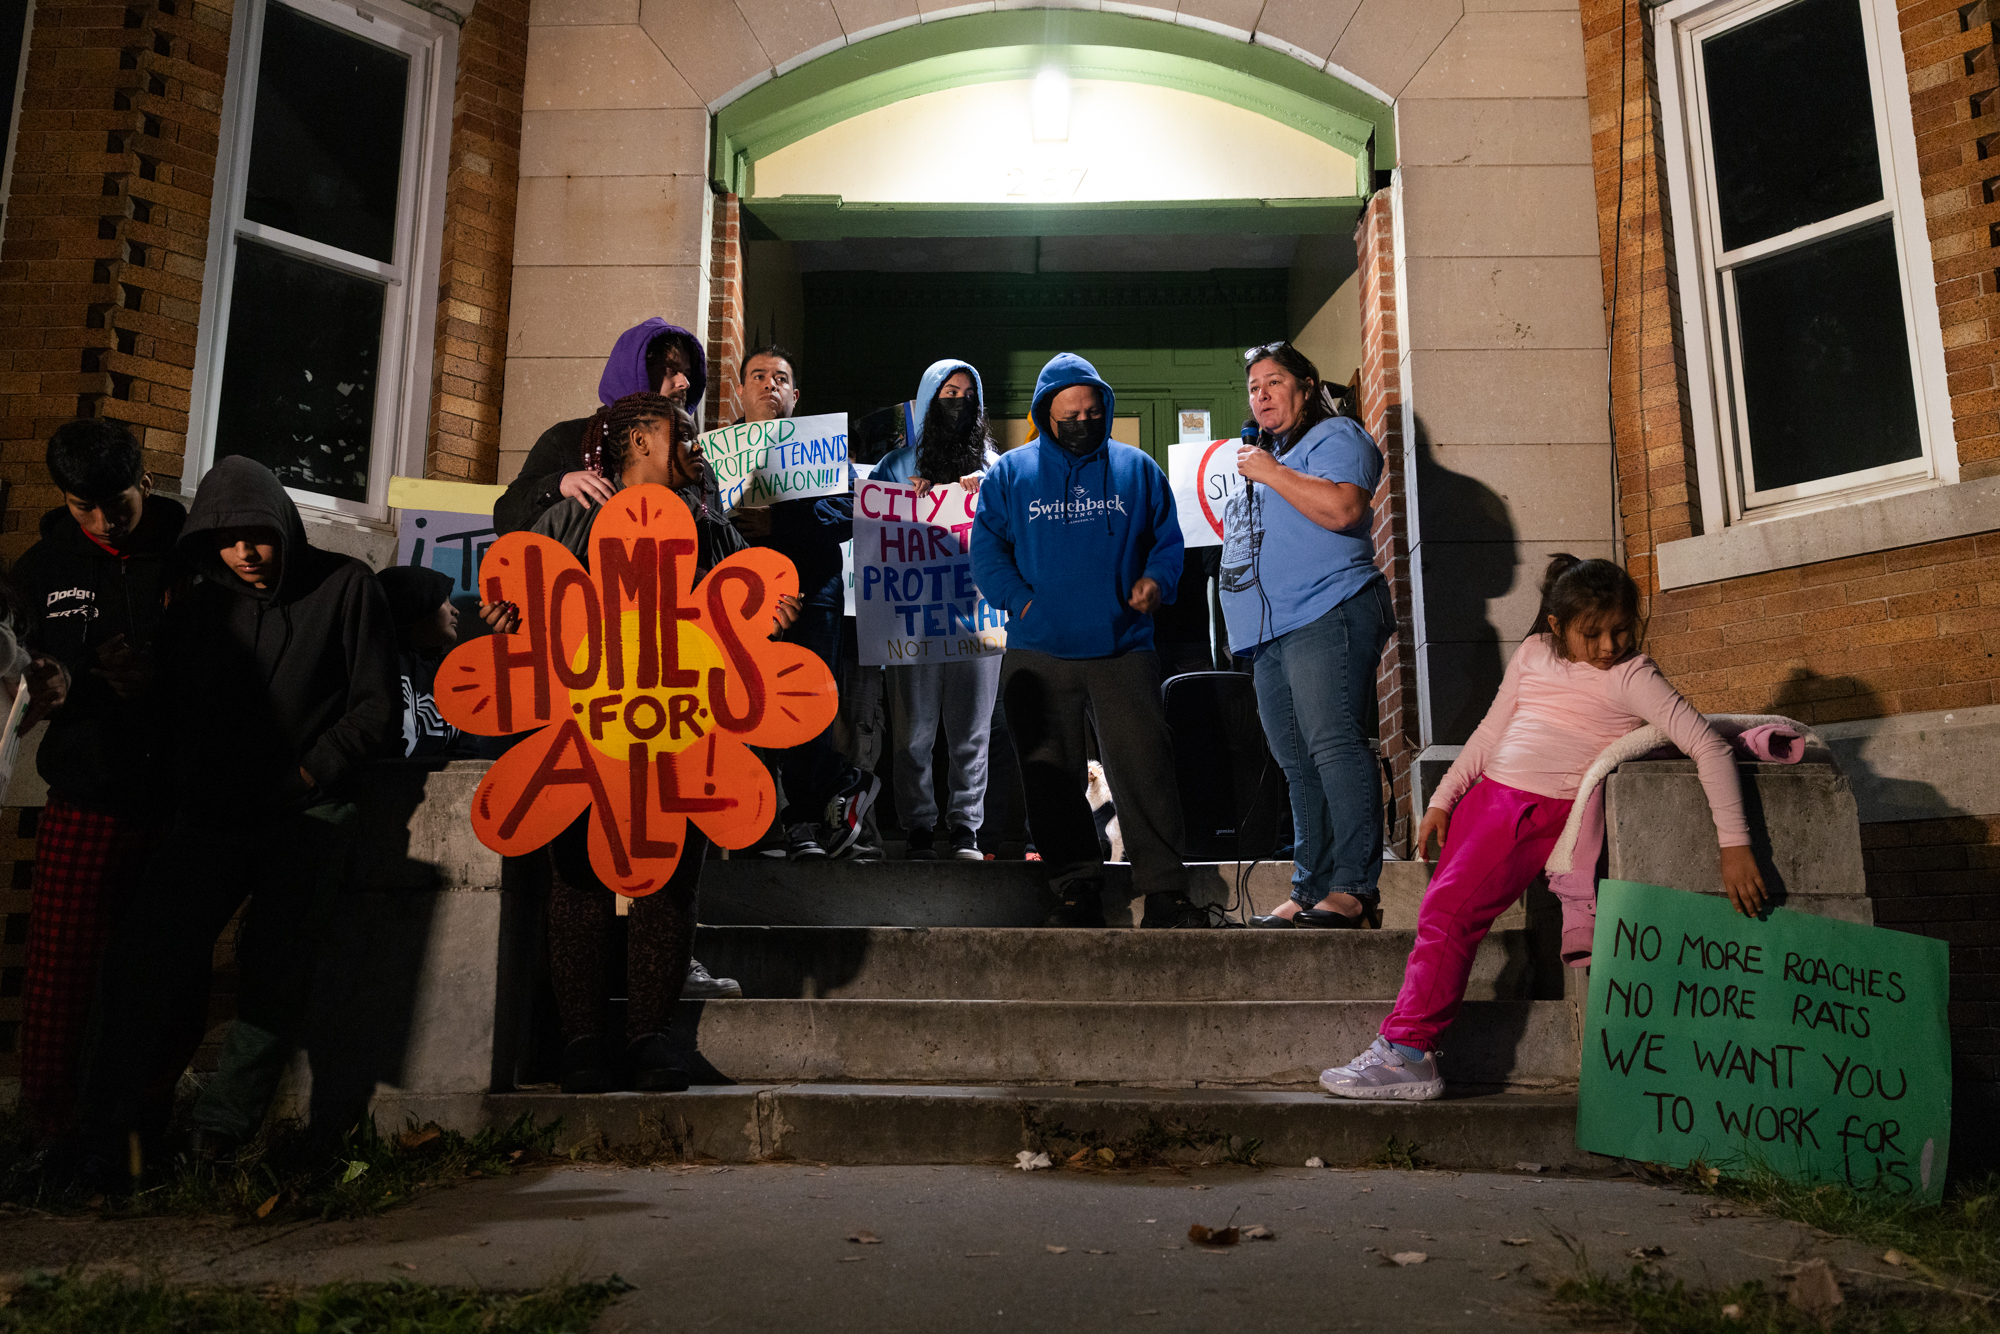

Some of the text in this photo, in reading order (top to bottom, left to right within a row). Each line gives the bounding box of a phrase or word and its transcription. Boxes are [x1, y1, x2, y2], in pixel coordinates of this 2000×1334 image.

[860, 484, 949, 523] CITY
[1029, 495, 1128, 523] Switchback
[486, 538, 766, 733] HOMES
[887, 638, 934, 660] NOT
[589, 694, 706, 740] FOR
[498, 719, 738, 878] ALL!
[1614, 918, 1906, 1003] NO MORE ROACHES
[1606, 978, 1870, 1038] NO MORE RATS
[1602, 1028, 1907, 1100] WE WANT YOU
[1643, 1091, 1694, 1134] TO
[1716, 1100, 1820, 1150] WORK
[1845, 1145, 1912, 1196] US
